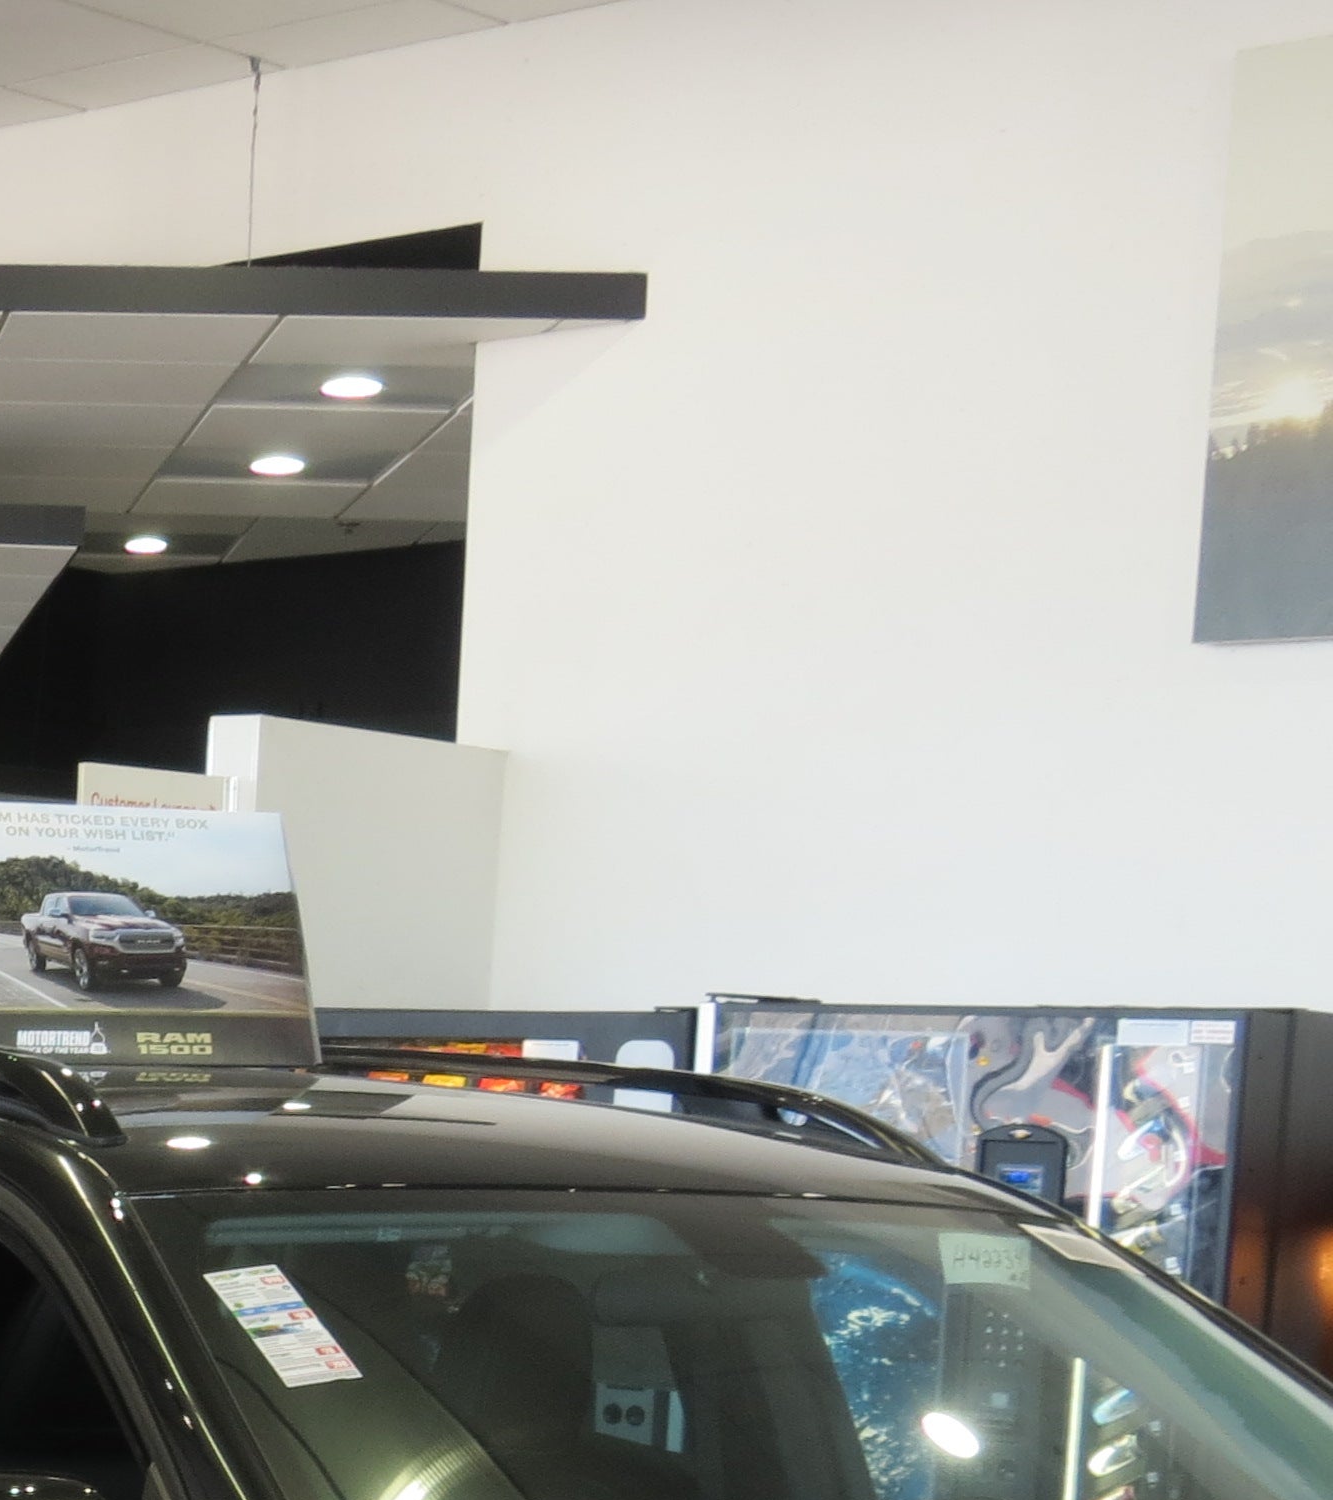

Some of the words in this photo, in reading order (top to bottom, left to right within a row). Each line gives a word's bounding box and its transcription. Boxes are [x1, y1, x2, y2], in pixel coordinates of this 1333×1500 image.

[17, 812, 51, 825] HAS
[54, 813, 115, 827] TICKED
[120, 816, 170, 829] EVERY
[175, 818, 209, 831] BOX
[5, 825, 30, 838] ON
[35, 826, 79, 839] YOUR
[79, 828, 127, 841] WISH
[16, 1030, 91, 1046] MOTORTREND
[136, 1032, 212, 1044] RAM
[137, 1044, 213, 1055] 1500
